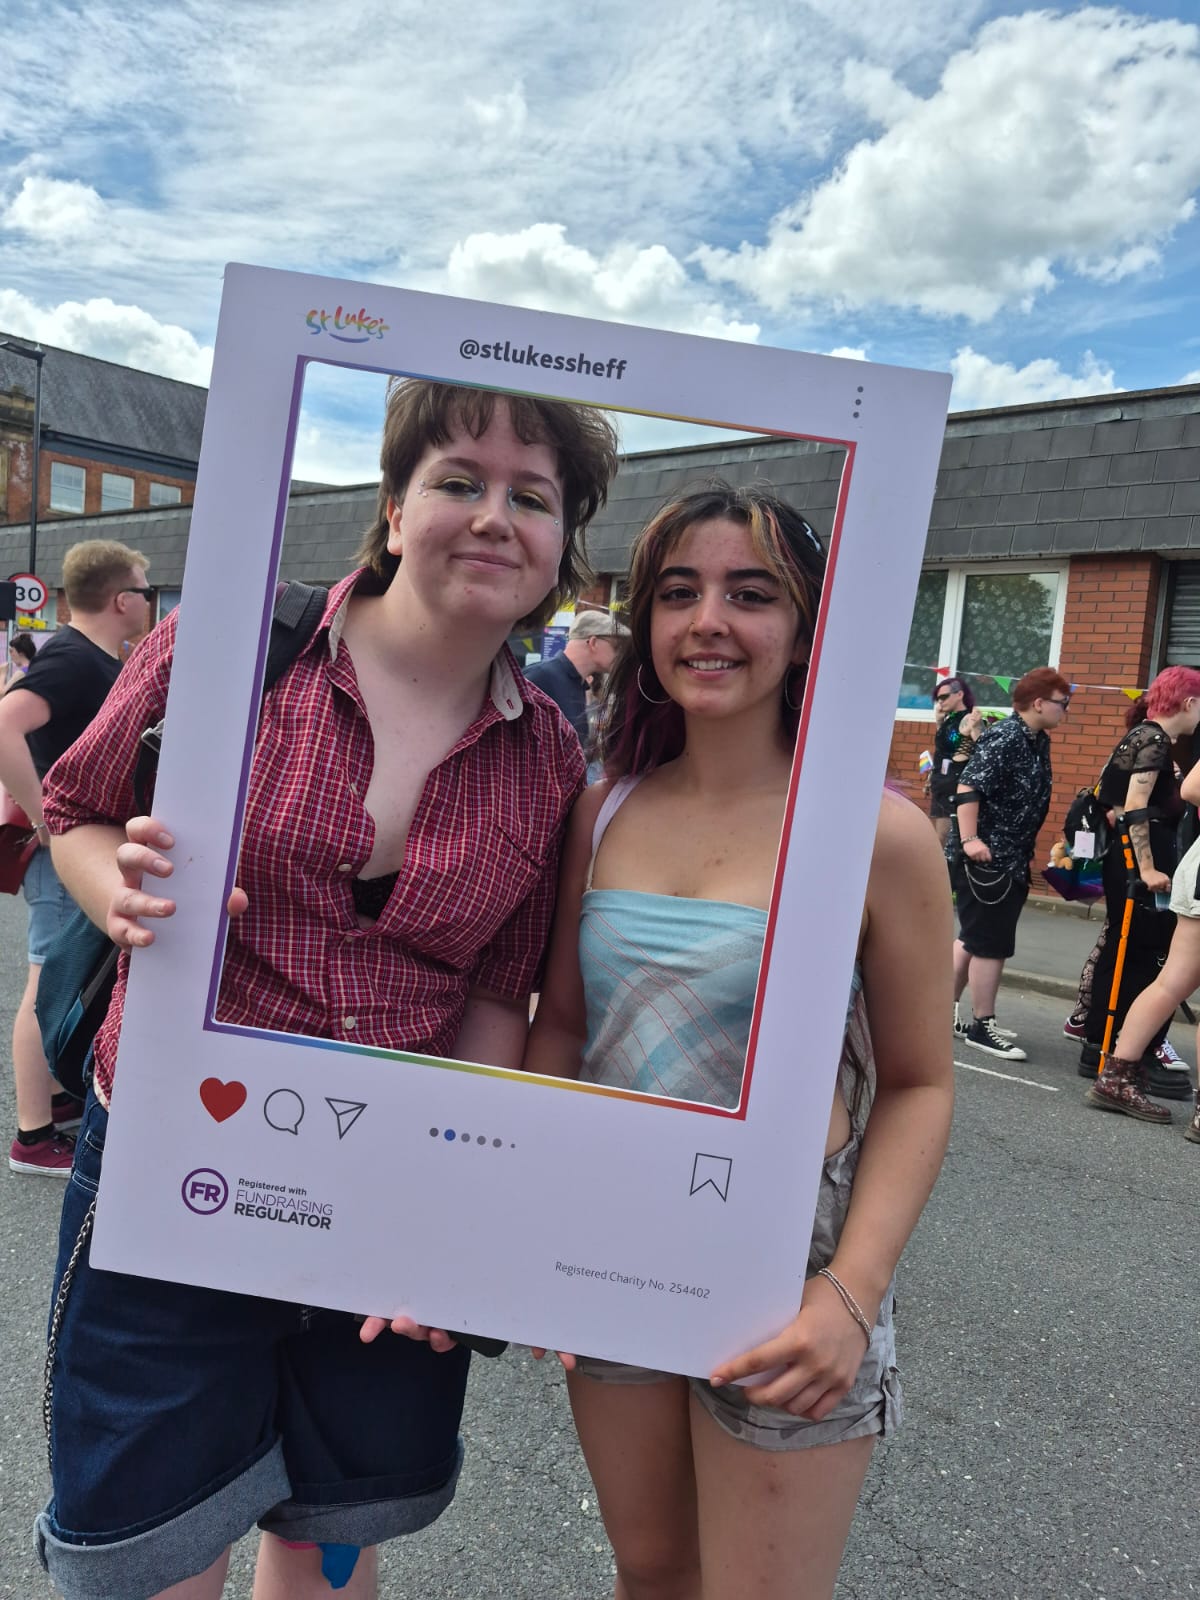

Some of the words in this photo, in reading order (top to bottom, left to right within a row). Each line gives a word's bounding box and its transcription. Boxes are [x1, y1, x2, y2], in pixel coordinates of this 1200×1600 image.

[459, 339, 627, 380] @stlukessheff
[16, 586, 41, 602] 30
[190, 1181, 221, 1203] FR
[238, 1178, 286, 1193] Registered
[288, 1186, 307, 1196] with
[234, 1202, 332, 1230] REGULATOR
[236, 1189, 333, 1216] FUNDRAISING
[555, 1261, 607, 1280] Registered
[609, 1271, 646, 1290] Charity
[669, 1282, 711, 1299] 254402
